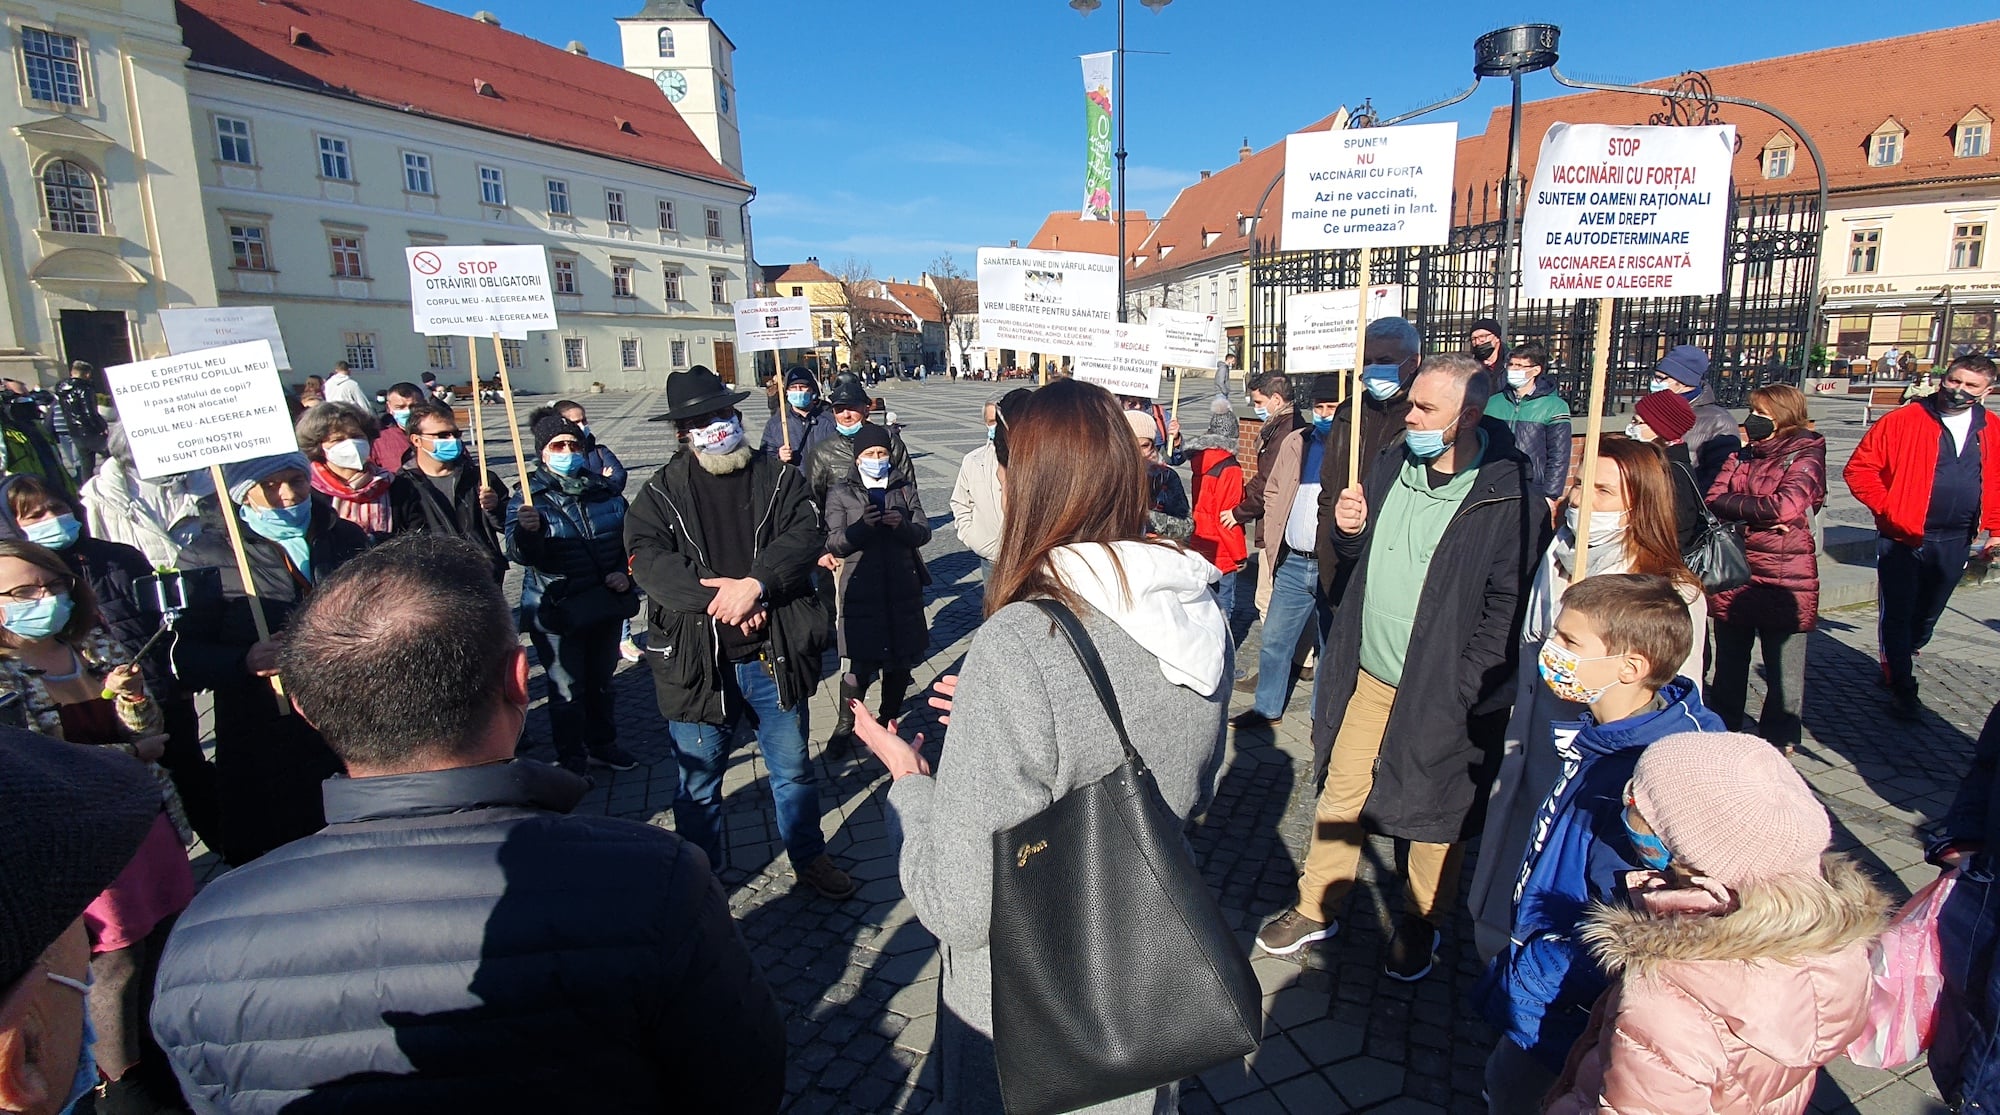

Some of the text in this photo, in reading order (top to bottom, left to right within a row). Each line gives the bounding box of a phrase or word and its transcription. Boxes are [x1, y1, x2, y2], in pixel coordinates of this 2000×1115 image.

[1344, 137, 1388, 149] SPUNEM
[1609, 137, 1640, 156] STOP
[1357, 153, 1374, 165] NU
[1310, 168, 1366, 181] VACCINĂRII
[1370, 168, 1384, 178] CU
[1552, 162, 1696, 190] VACCINĂRII CU FORȚA!
[1315, 187, 1417, 202] Azi ne vaccinati,
[1538, 192, 1711, 209] SUNTEM OAMENI RAȚIONALI
[1292, 209, 1328, 219] maine
[1332, 208, 1346, 217] ne
[1351, 204, 1390, 219] puneti
[1394, 204, 1405, 215] in
[1579, 212, 1657, 225] AVEM DREPT
[1324, 220, 1405, 234] Ce urmeaza?
[1546, 231, 1689, 245] DE AUTODETERMINARE
[1033, 260, 1046, 268] VINE
[1048, 261, 1059, 269] DIN
[1539, 252, 1691, 269] VACCINAREA E RISCANTĂ
[458, 261, 497, 275] STOP
[426, 275, 541, 289] OTRĂVIRII OBLIGATORII
[1550, 273, 1672, 289] RĂMÂNE O ALEGERE
[427, 298, 460, 306] CORPUL
[984, 302, 1004, 310] VREM
[1006, 304, 1040, 314] LIBERTATE
[1042, 308, 1070, 317] PENTRU
[430, 317, 464, 325] COPILUL
[490, 314, 530, 322] ALEGEREA
[1052, 324, 1078, 332] EPIDEMIE
[1116, 329, 1128, 337] TOP
[1293, 328, 1316, 336] pentru
[1120, 342, 1150, 352] MEDICALE
[152, 357, 226, 378] E DREPTUL MEU
[1081, 361, 1111, 370] INFORMARE
[131, 381, 160, 393] DECID
[163, 373, 199, 387] PENTRU
[201, 366, 242, 380] COPILUL
[244, 361, 269, 372] MEU!
[152, 396, 174, 408] pasa
[176, 389, 208, 404] statului
[210, 387, 222, 395] de
[224, 381, 251, 395] copii?
[164, 406, 175, 415] 84
[177, 403, 196, 413] RON
[131, 424, 170, 438] COPILUL
[173, 420, 193, 431] MEU
[199, 410, 252, 425] ALEGEREA
[254, 405, 278, 416] MEA!
[158, 455, 171, 464] NU
[173, 450, 197, 462] SUNT
[200, 444, 233, 456] COBAII
